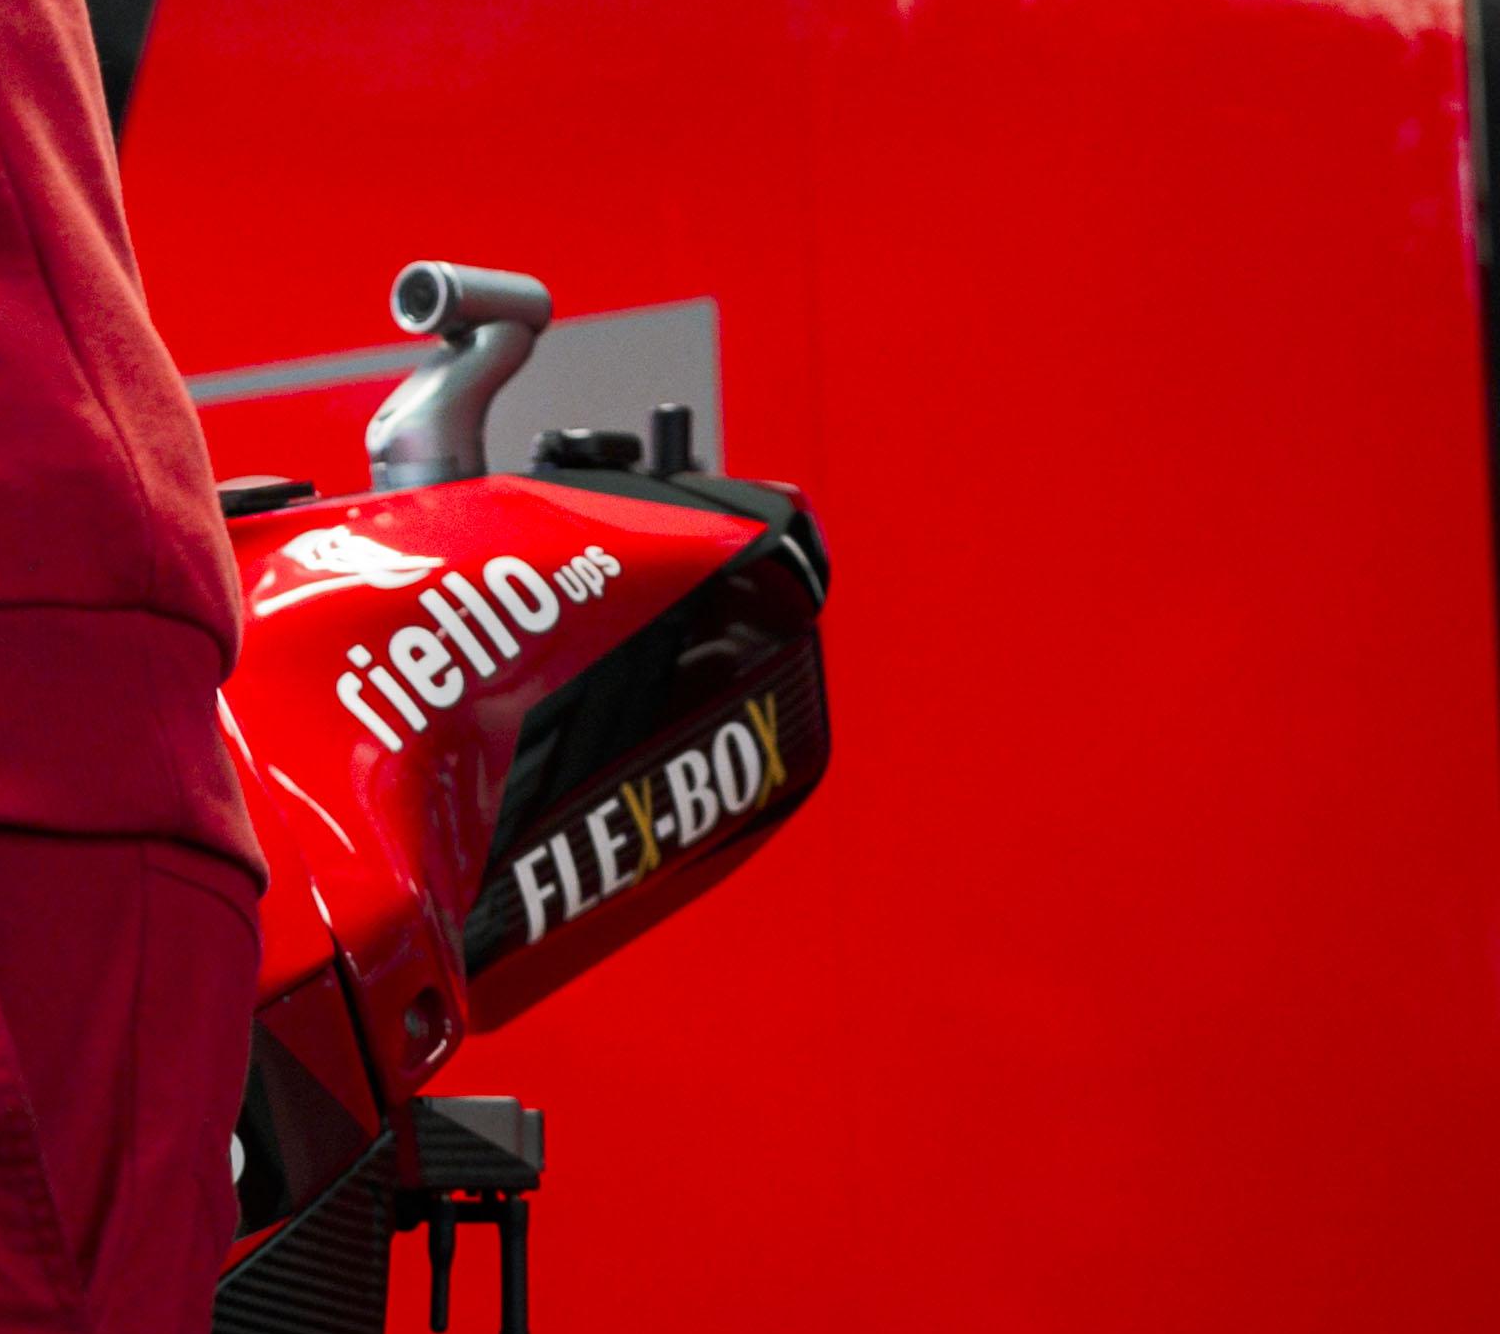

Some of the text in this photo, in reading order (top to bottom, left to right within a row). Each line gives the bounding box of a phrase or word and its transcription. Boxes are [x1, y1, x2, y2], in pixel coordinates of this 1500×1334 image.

[336, 544, 622, 752] riello ups
[513, 692, 786, 945] FLEX-BOX
